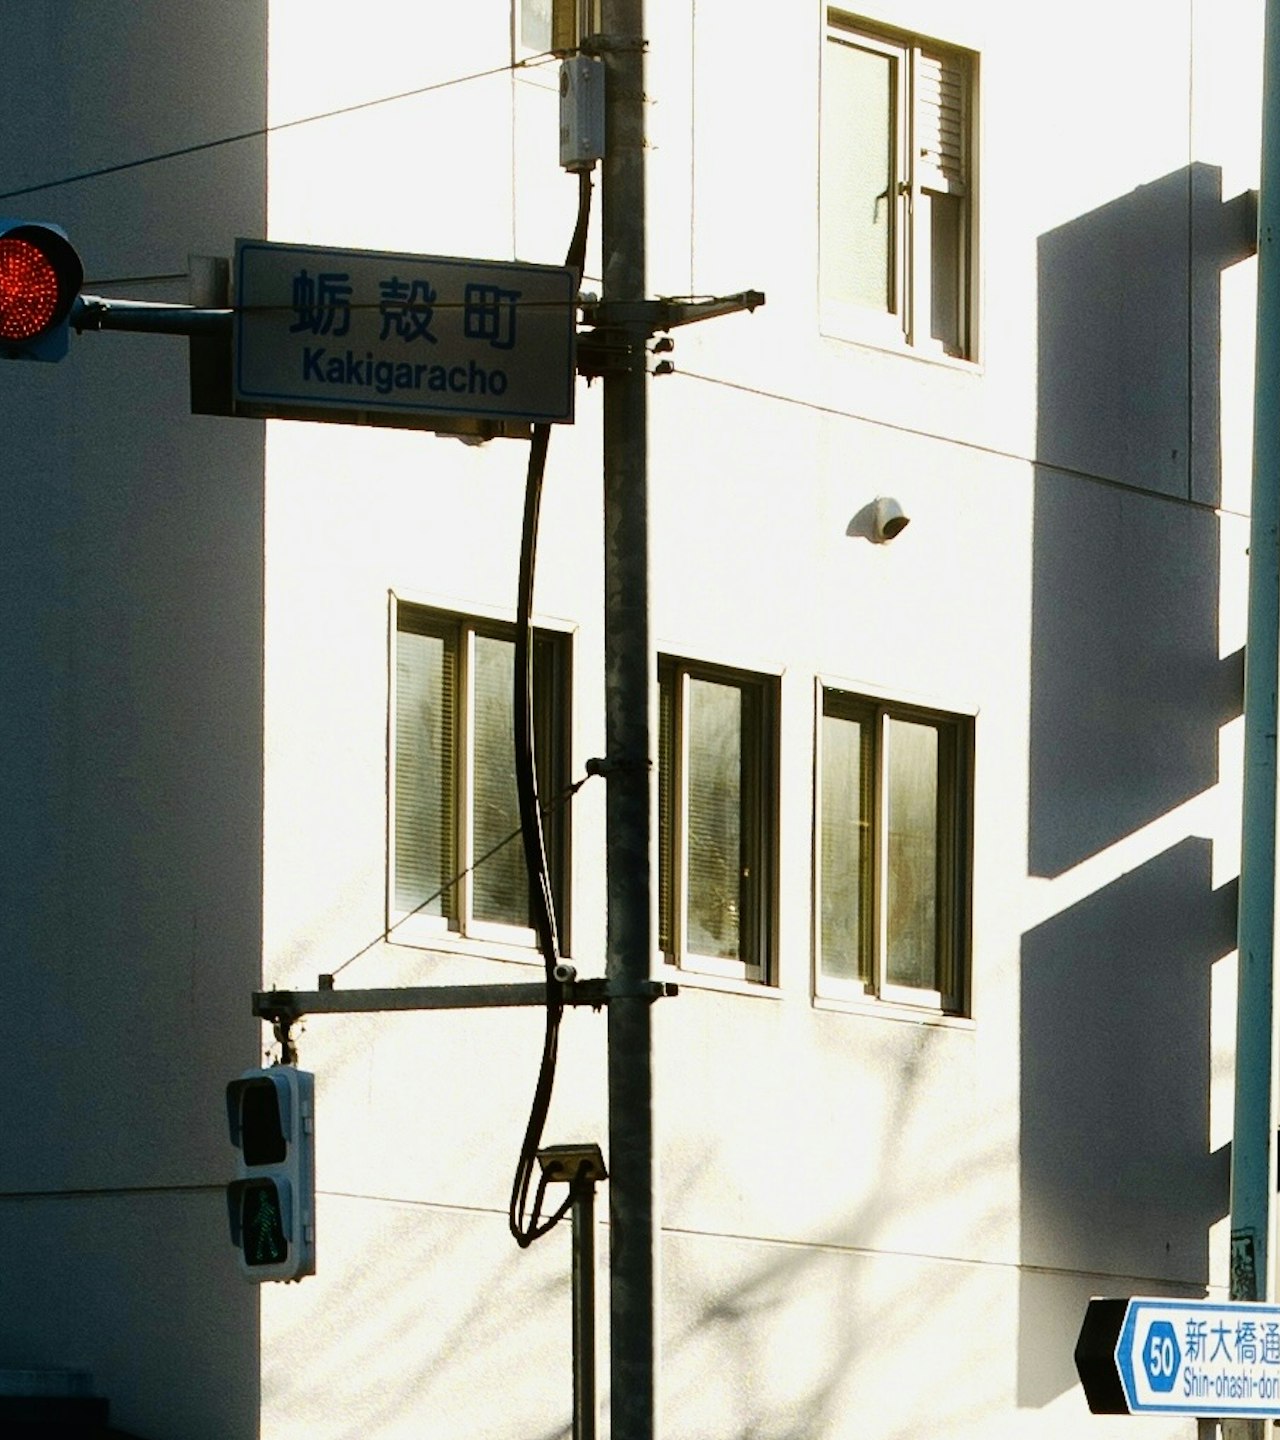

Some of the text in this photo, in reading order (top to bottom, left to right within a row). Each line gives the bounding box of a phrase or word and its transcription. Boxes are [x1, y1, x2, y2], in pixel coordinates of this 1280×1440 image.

[290, 268, 522, 350] 蛎殻町
[302, 348, 509, 396] Kakigaracho
[1150, 1337, 1174, 1377] 50
